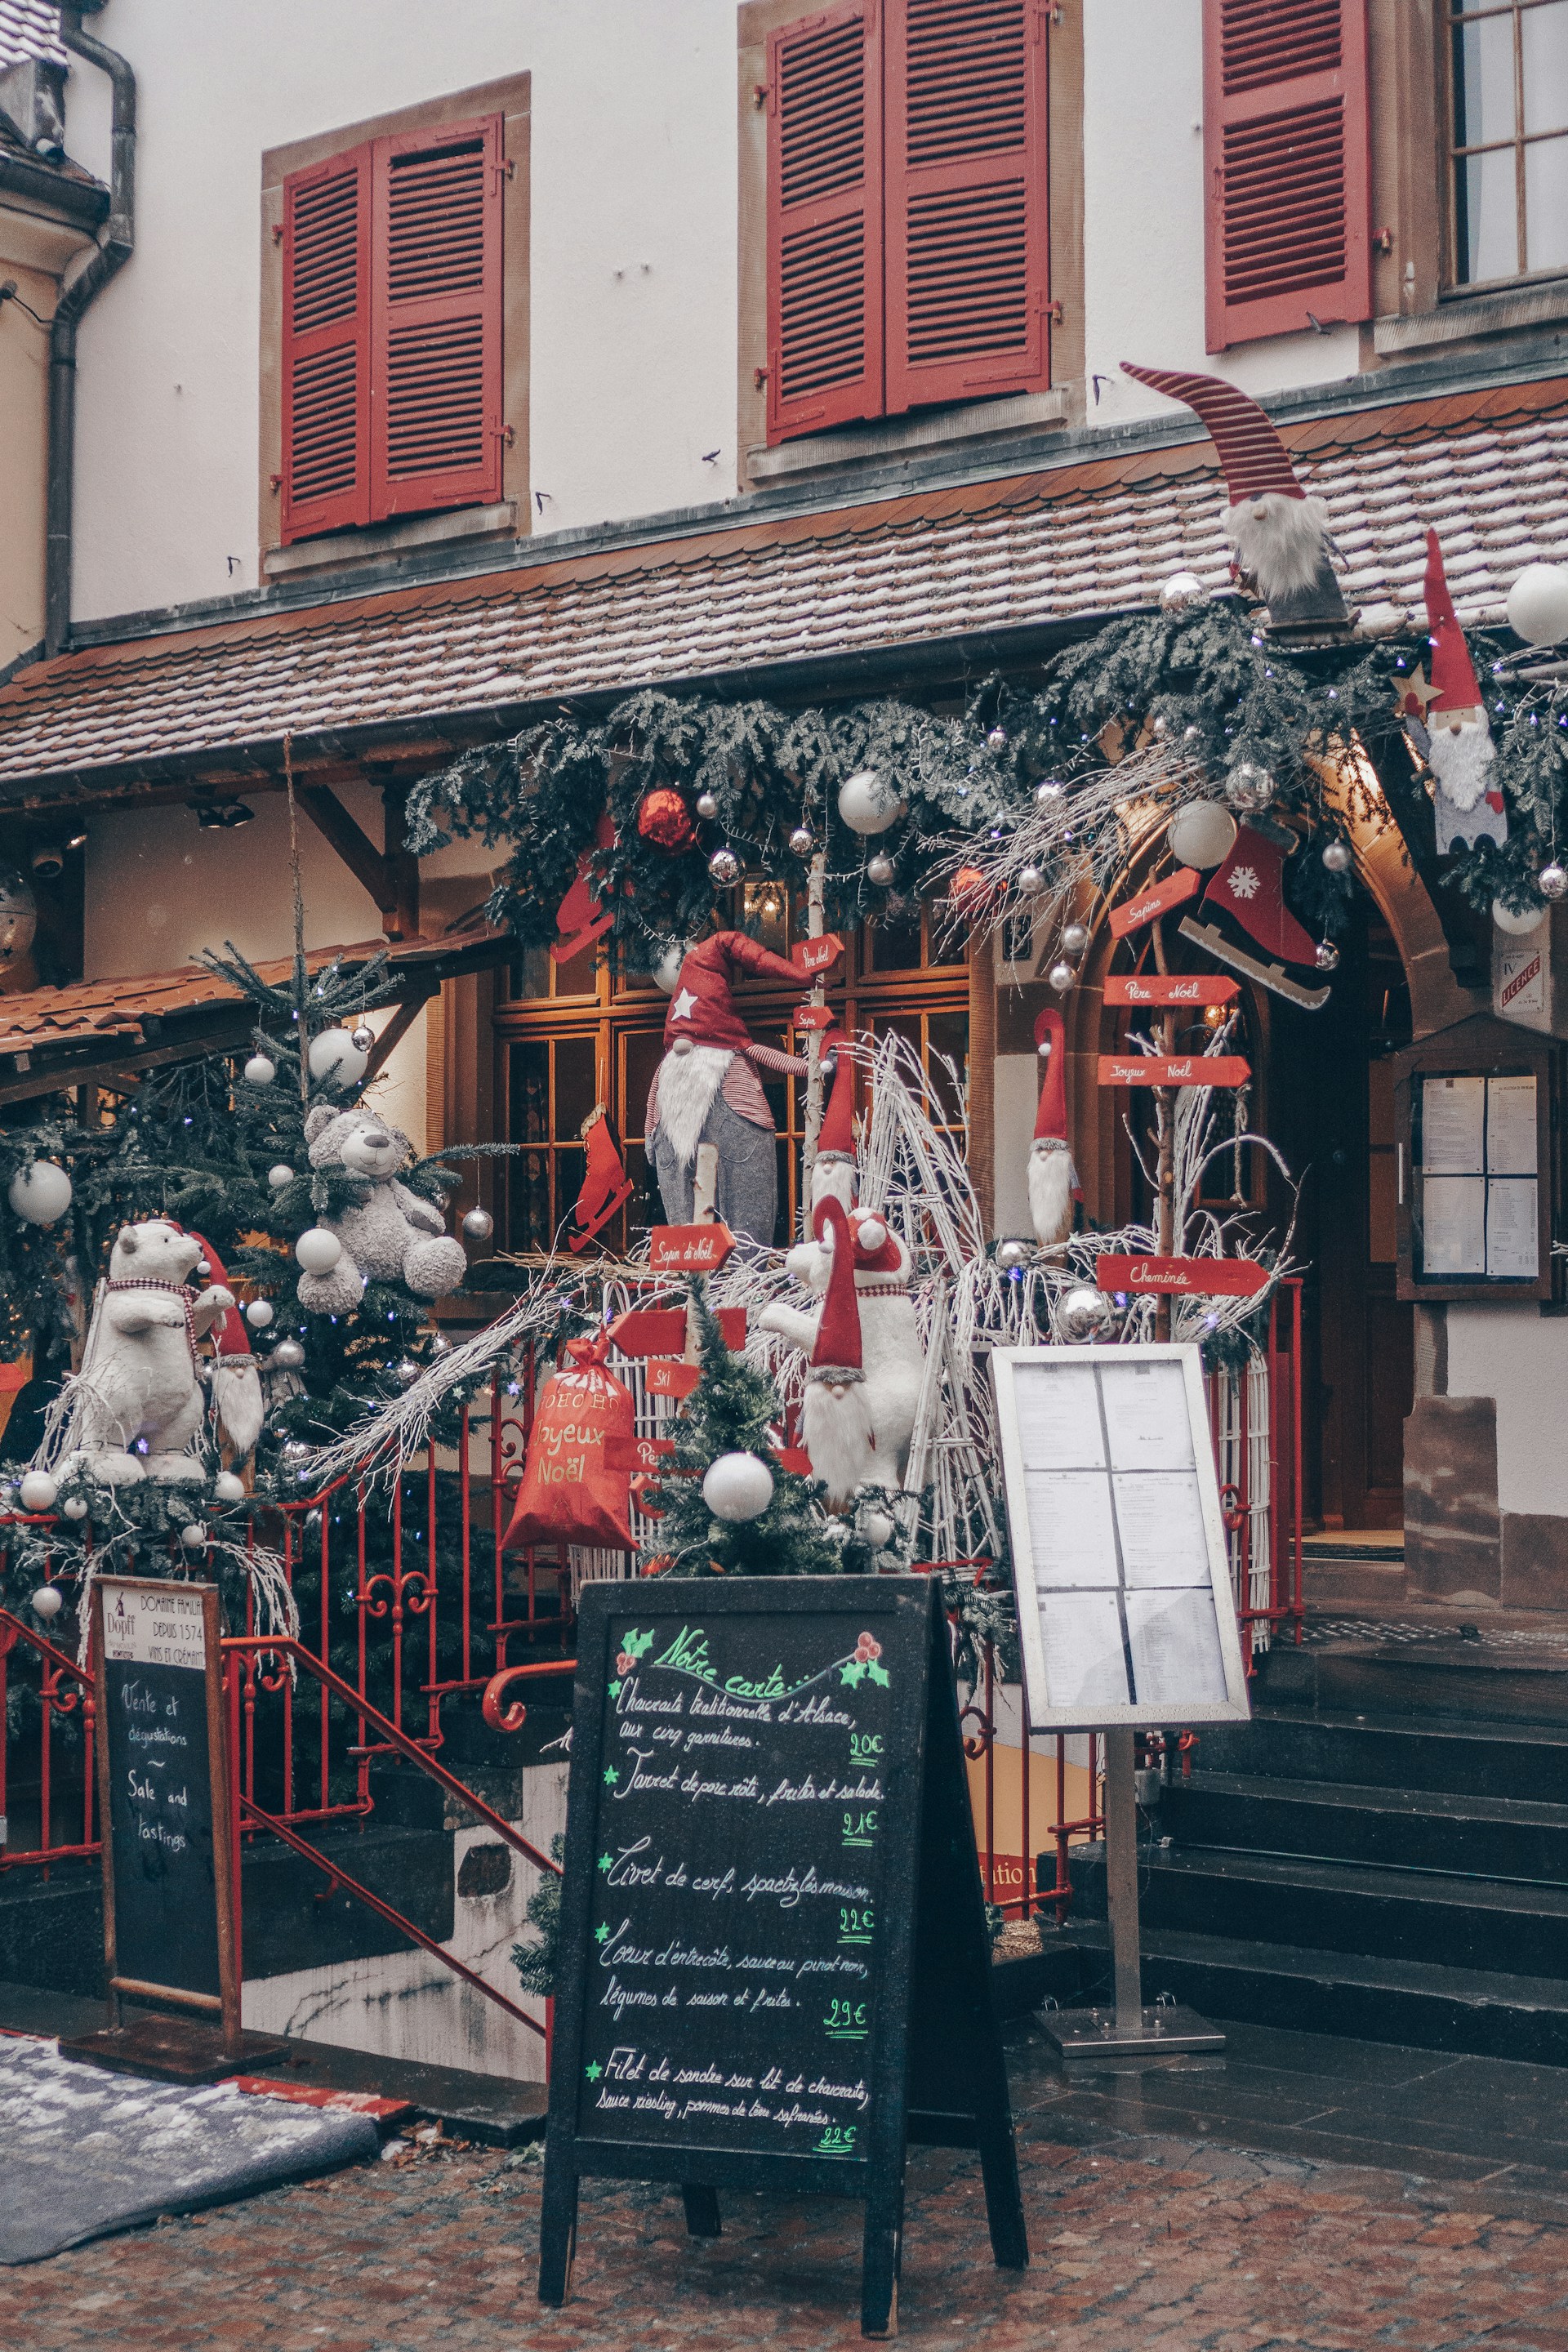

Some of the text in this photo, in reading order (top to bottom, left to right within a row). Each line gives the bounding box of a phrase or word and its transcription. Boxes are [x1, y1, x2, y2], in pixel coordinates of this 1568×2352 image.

[1128, 899, 1161, 923] Sapins
[1503, 958, 1539, 1006] LICENCE
[1504, 963, 1517, 975] IV
[1125, 982, 1200, 1000] Père Noël
[798, 1013, 816, 1028] Sapin
[1110, 1060, 1192, 1083] Joyeux Noël
[654, 1241, 680, 1270] Sapin
[1129, 1262, 1192, 1285] Cheminée
[653, 1370, 671, 1388] Ski
[533, 1419, 605, 1456] Joyeux
[537, 1454, 586, 1486] Noël
[140, 1595, 175, 1615] DOMAINE
[107, 1612, 136, 1641] Dopff
[153, 1621, 203, 1642] DEPUIS 1574
[147, 1646, 163, 1662] VINS
[164, 1647, 172, 1663] ET
[653, 1624, 718, 1682] Notre
[121, 1679, 180, 1716] Vente et
[777, 1695, 857, 1731] d'Alsace,
[127, 1723, 188, 1749] dégustations
[619, 1720, 761, 1753] aux cinq garnitures.
[849, 1732, 884, 1757] 20€
[127, 1769, 188, 1806] Sale and
[613, 1745, 679, 1799] Jarret
[680, 1769, 698, 1792] de
[766, 1773, 816, 1807] frites
[817, 1778, 836, 1800] et
[137, 1812, 186, 1852] tastings
[841, 1810, 880, 1836] 21€
[607, 1835, 663, 1886] Civet
[665, 1861, 688, 1887] de
[692, 1866, 736, 1901] cerf,
[818, 1881, 875, 1904] maison.
[839, 1907, 875, 1933] 22€
[654, 1939, 733, 1971] d'entrecôte,
[735, 1955, 777, 1970] sauce
[777, 1959, 795, 1971] au
[795, 1954, 840, 1980] pinot
[599, 1974, 801, 2021] légumes de saison et frites.
[822, 1998, 866, 2028] 29€
[604, 2046, 645, 2081] Filet
[648, 2056, 670, 2082] de
[672, 2061, 724, 2084] sandre
[724, 2072, 754, 2089] sur
[759, 2065, 782, 2091] lit
[785, 2073, 804, 2093] de
[631, 2088, 682, 2120] riesling,
[680, 2099, 730, 2120] pommes
[731, 2099, 746, 2118] de
[819, 2126, 858, 2146] 22€
